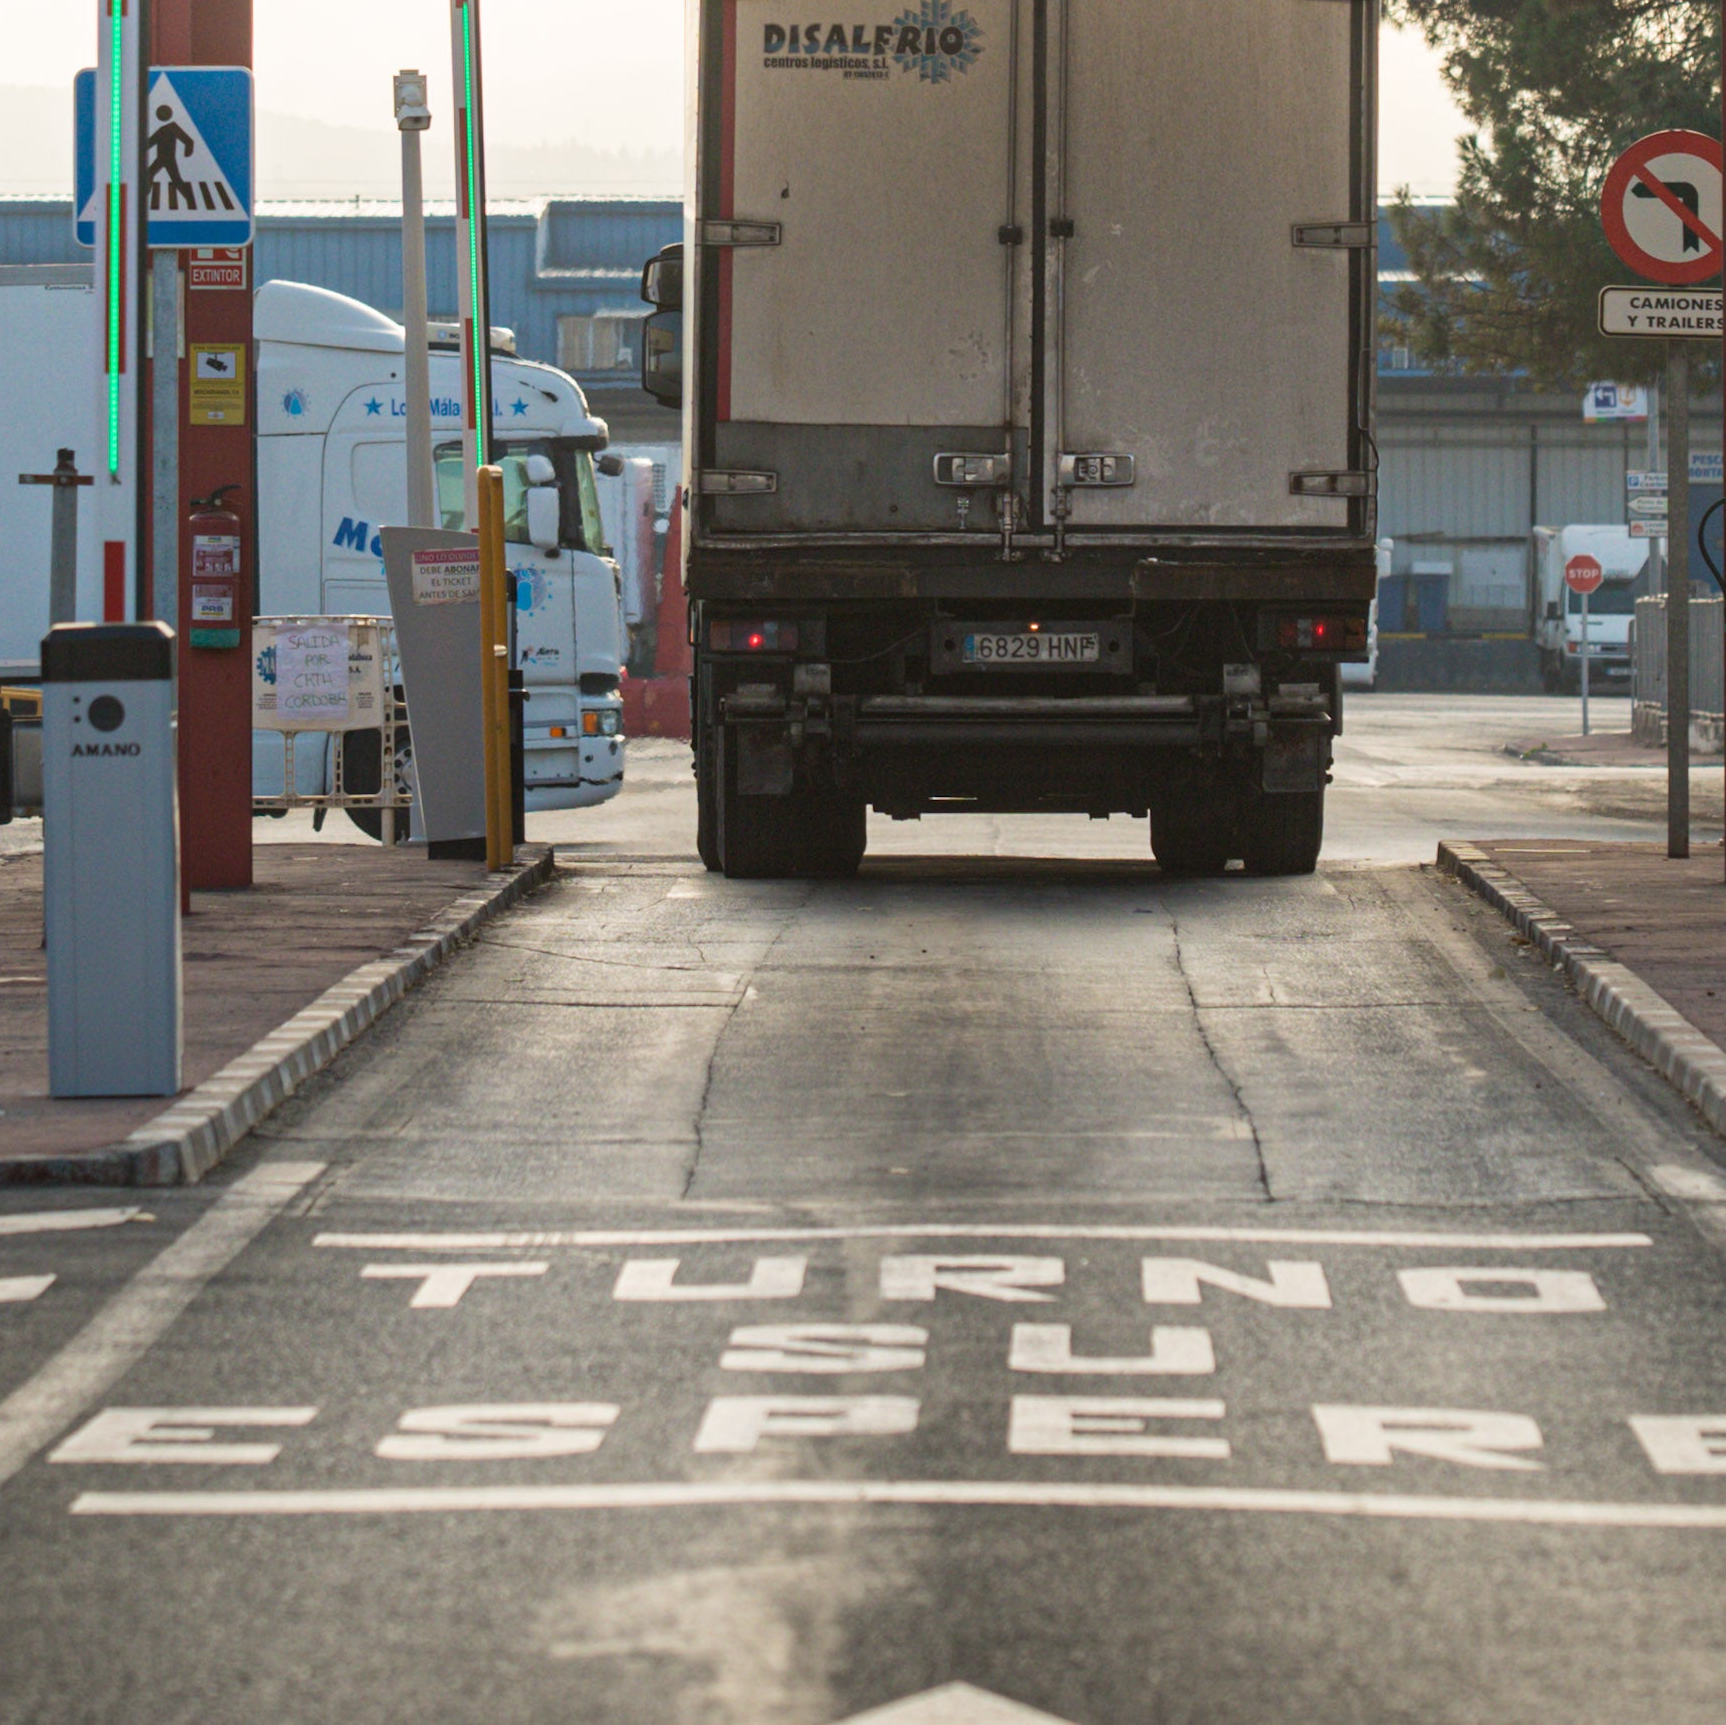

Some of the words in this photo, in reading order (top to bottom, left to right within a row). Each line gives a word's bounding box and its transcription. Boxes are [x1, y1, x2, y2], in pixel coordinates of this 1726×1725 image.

[763, 23, 965, 57] DISALFRIO
[763, 57, 808, 69] centros
[192, 268, 241, 283] EXTINTOR
[1629, 296, 1724, 311] CAMIONES
[1627, 315, 1638, 328] Y
[1646, 316, 1724, 330] TRAILERS
[420, 565, 442, 575] DEBE
[1568, 568, 1600, 579] STOP
[431, 578, 441, 586] EL
[443, 576, 472, 586] TICKET
[419, 590, 447, 599] ANTES
[449, 589, 460, 598] DE
[287, 634, 341, 650] SALIDA
[979, 636, 1040, 659] 6829
[304, 654, 332, 668] POR
[284, 694, 348, 710] CORDOBA
[71, 742, 141, 758] AMANO
[358, 1254, 1609, 1313] TURNO
[719, 1322, 1217, 1375] SU
